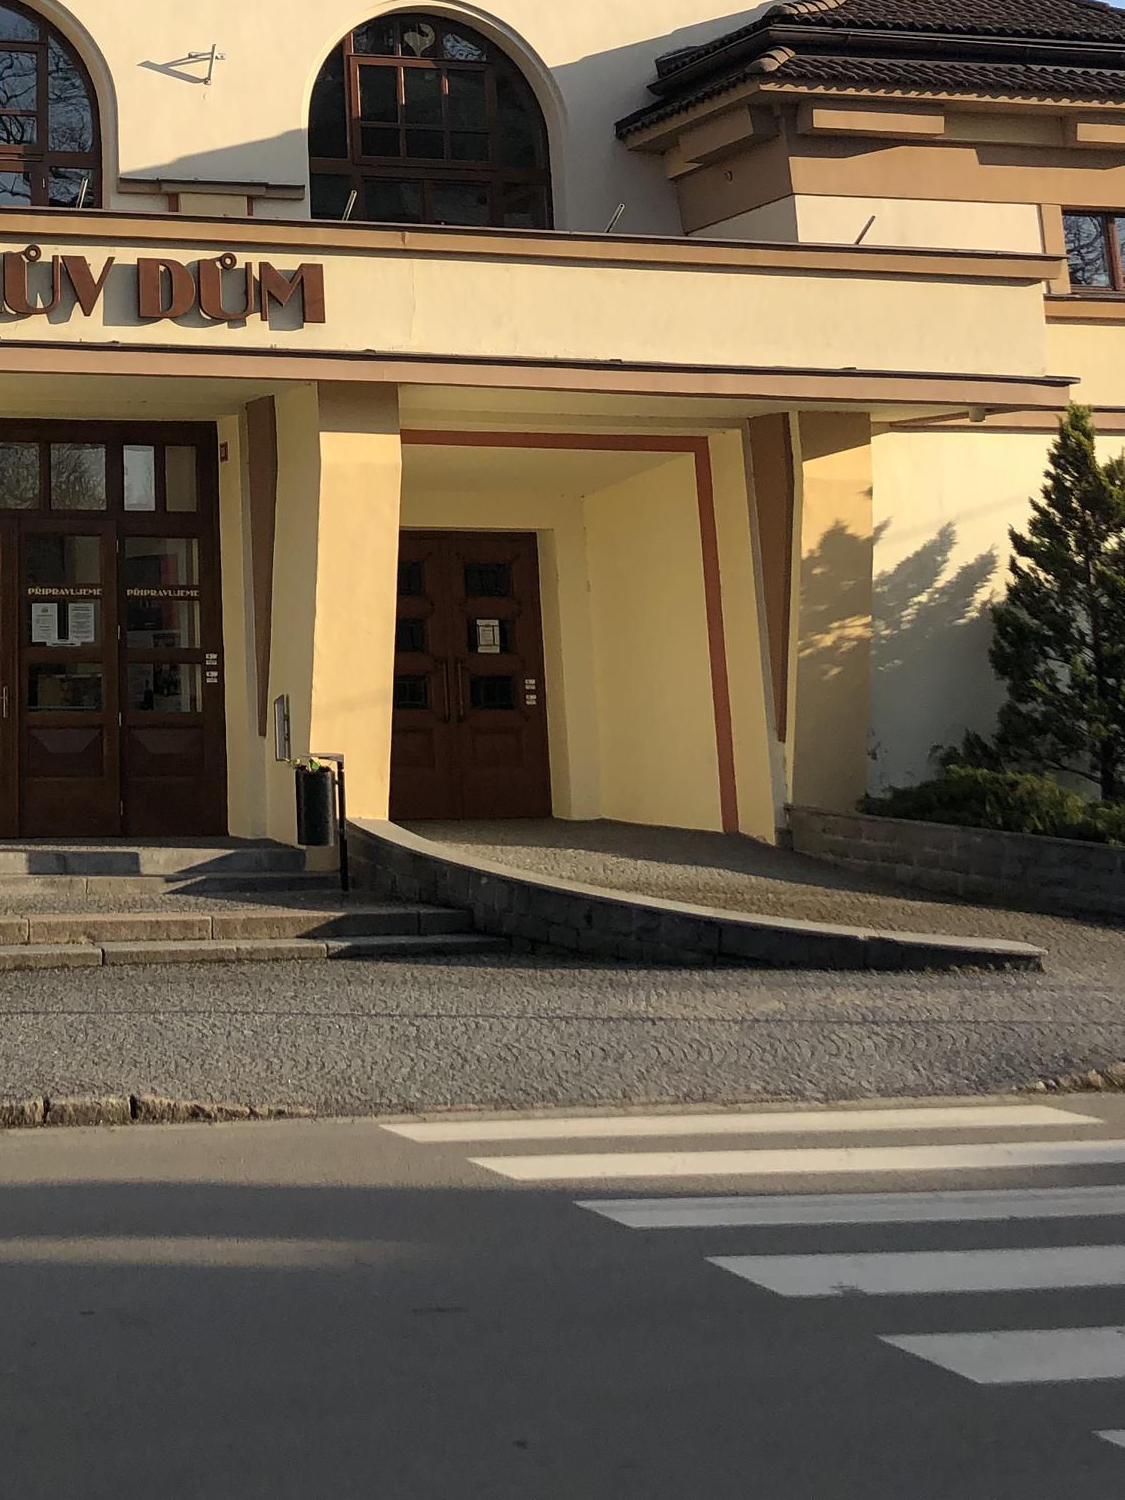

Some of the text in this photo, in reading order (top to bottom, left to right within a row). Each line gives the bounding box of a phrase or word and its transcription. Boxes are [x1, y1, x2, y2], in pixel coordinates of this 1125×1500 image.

[138, 252, 325, 324] DŮM
[27, 586, 102, 596] PŘIPRAVUJEME
[126, 587, 199, 597] PŘIPRAVUJEME
